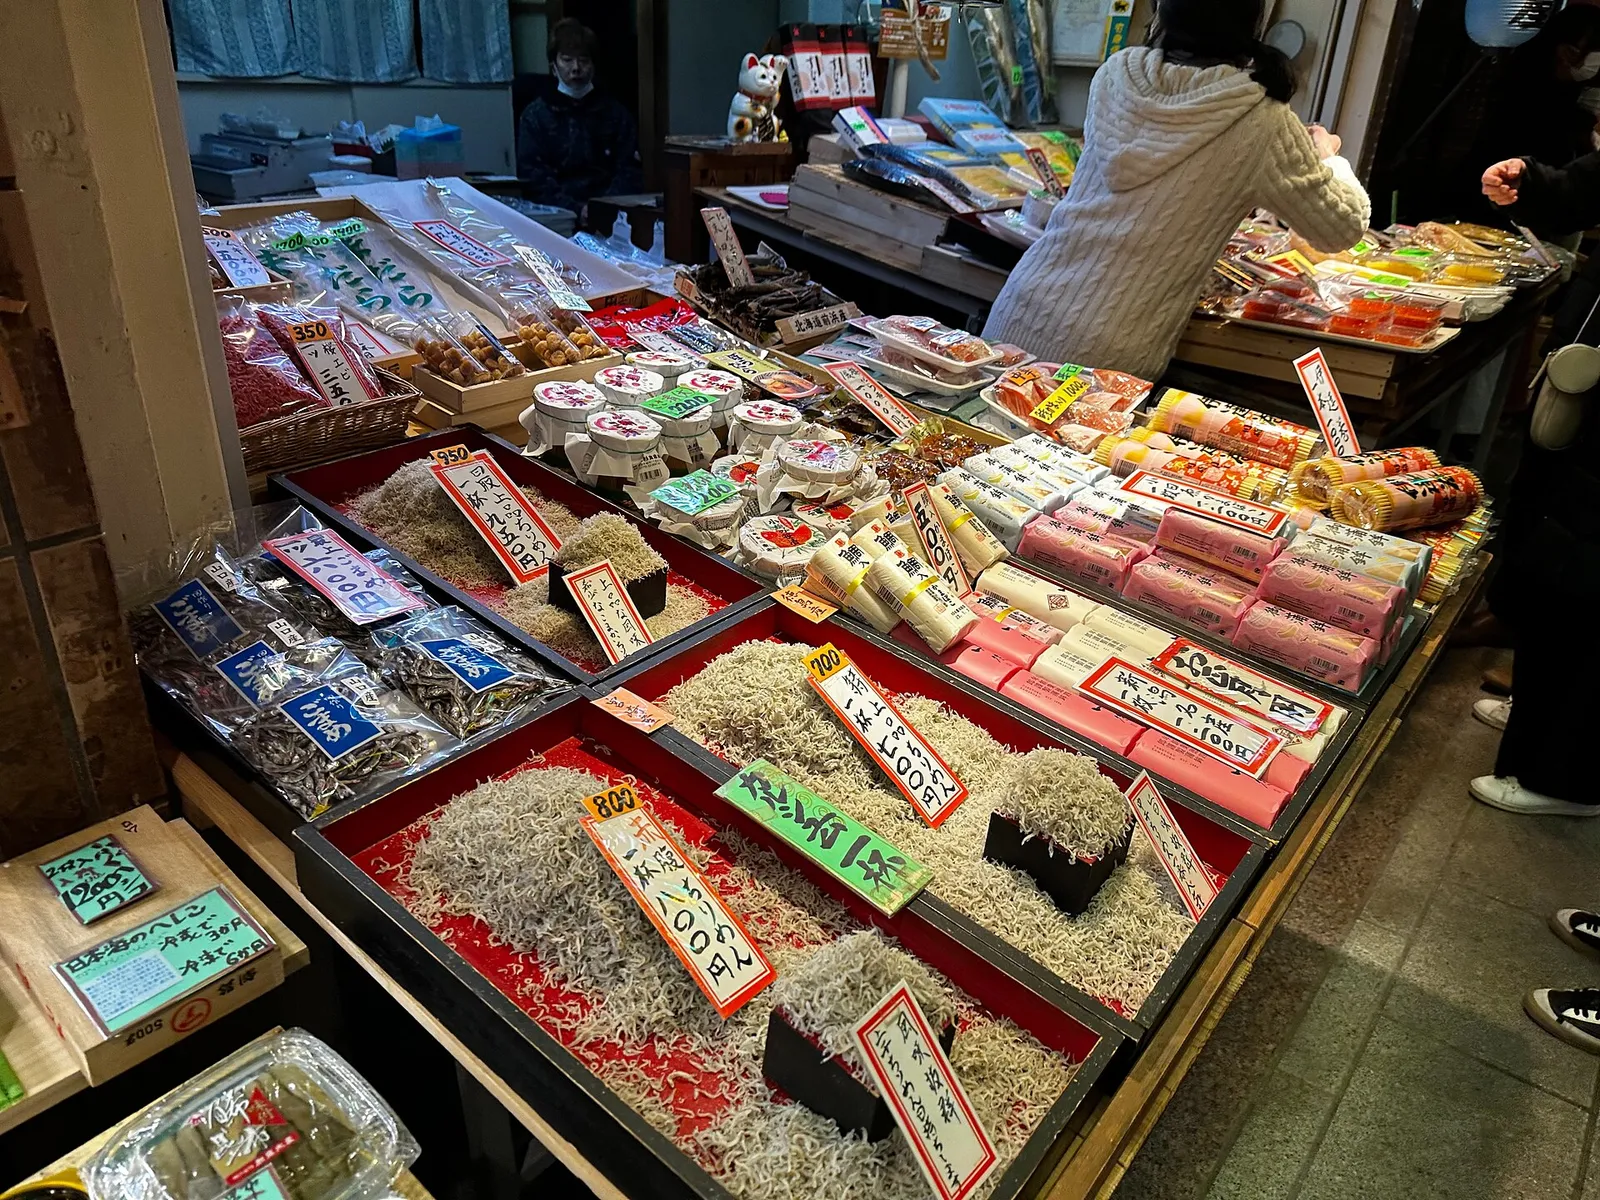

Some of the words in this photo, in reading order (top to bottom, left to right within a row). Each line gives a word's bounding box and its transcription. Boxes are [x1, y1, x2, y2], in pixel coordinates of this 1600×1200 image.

[293, 323, 327, 340] 350
[794, 310, 847, 332] 北海道前浜産
[321, 342, 351, 381] 桜エビ
[437, 446, 469, 467] 950
[458, 479, 488, 511] 一杯
[470, 464, 552, 565] 最上品ちりめん
[306, 534, 387, 591] 最上ごまめ
[598, 577, 646, 647] 上品な風味
[780, 589, 828, 616] 徳島産
[273, 619, 302, 645] 山口産
[810, 648, 842, 678] 700
[1114, 670, 1234, 736] 新潟名産
[1172, 645, 1316, 727] お正月用
[299, 697, 353, 744] ごまめ
[841, 667, 956, 801] 特上品ちりめん
[844, 698, 873, 734] 一杯
[592, 786, 636, 819] 800
[622, 848, 660, 892] 一杯
[66, 903, 207, 972] 日本海のへしこ
[159, 913, 218, 952] 冷蔵で
[897, 1010, 962, 1125] 風味抜群
